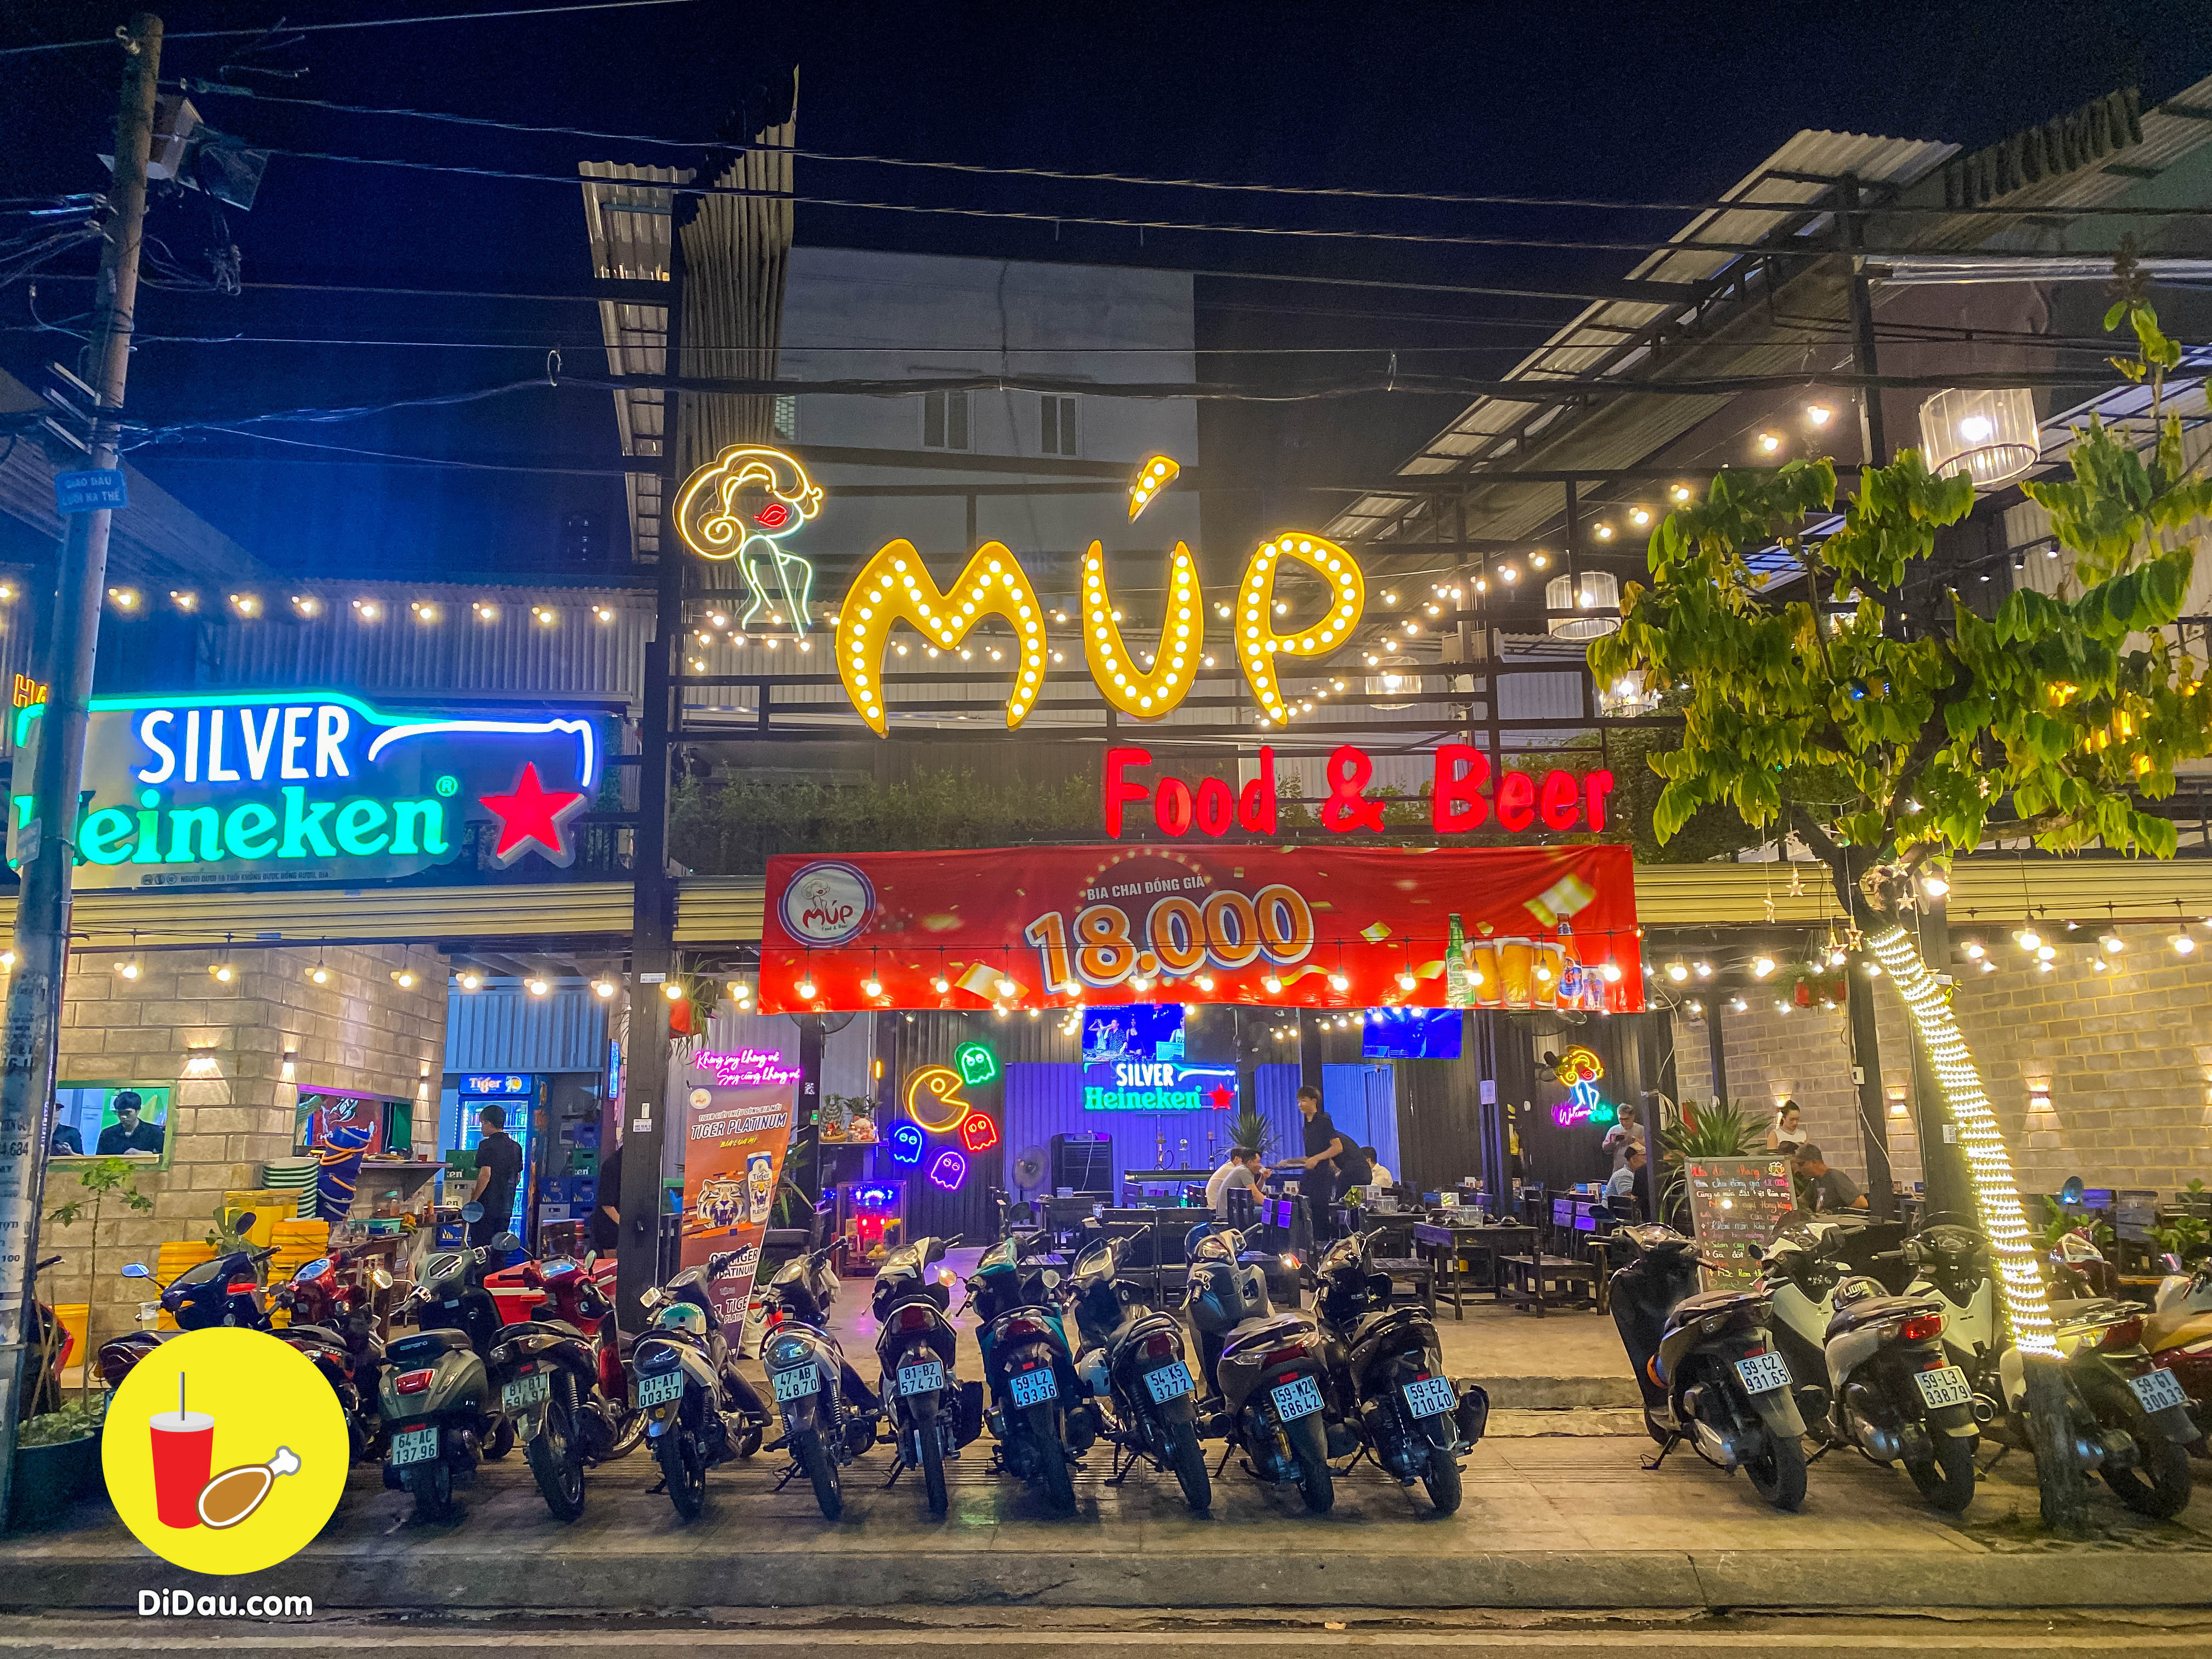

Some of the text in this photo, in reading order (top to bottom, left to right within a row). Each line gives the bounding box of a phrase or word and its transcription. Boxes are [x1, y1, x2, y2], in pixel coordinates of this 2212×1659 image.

[836, 455, 1365, 738] MÚP
[138, 706, 350, 784] SILVER
[1105, 743, 1615, 839] Food & Beer
[8, 786, 449, 869] eineken
[1086, 873, 1205, 901] BIA CHAI ĐỒNG GIÁ
[802, 900, 854, 929] MÚP
[1024, 884, 1315, 994] 18.000
[469, 1076, 503, 1093] Tiger
[1116, 1063, 1174, 1087] SILVER
[1084, 1085, 1202, 1110] Heineken
[691, 1112, 788, 1141] TIGER PLATINUM
[725, 1295, 749, 1313] TIGE
[905, 1364, 935, 1379] 81-B2
[1151, 1366, 1182, 1386] 54-K5
[1743, 1356, 1777, 1375] 59-C2
[645, 1373, 675, 1391] 81-AT
[781, 1368, 810, 1385] 47-AB
[902, 1376, 941, 1393] 574.20
[1016, 1372, 1048, 1390] 59-L2
[1746, 1370, 1788, 1391] 931.65
[1921, 1371, 1957, 1389] 59-L3
[641, 1386, 680, 1407] 003.57
[778, 1379, 817, 1400] 248.70
[1016, 1388, 1056, 1406] 493.36
[1156, 1379, 1189, 1400] 3272
[1278, 1381, 1310, 1402] 59-M2
[1411, 1379, 1444, 1398] 59-E2
[1927, 1386, 1968, 1404] 338.79
[1282, 1395, 1319, 1418] 686.42
[1413, 1393, 1452, 1415] 210.40
[398, 1430, 432, 1447] 64-AC
[397, 1444, 435, 1463] 137.96
